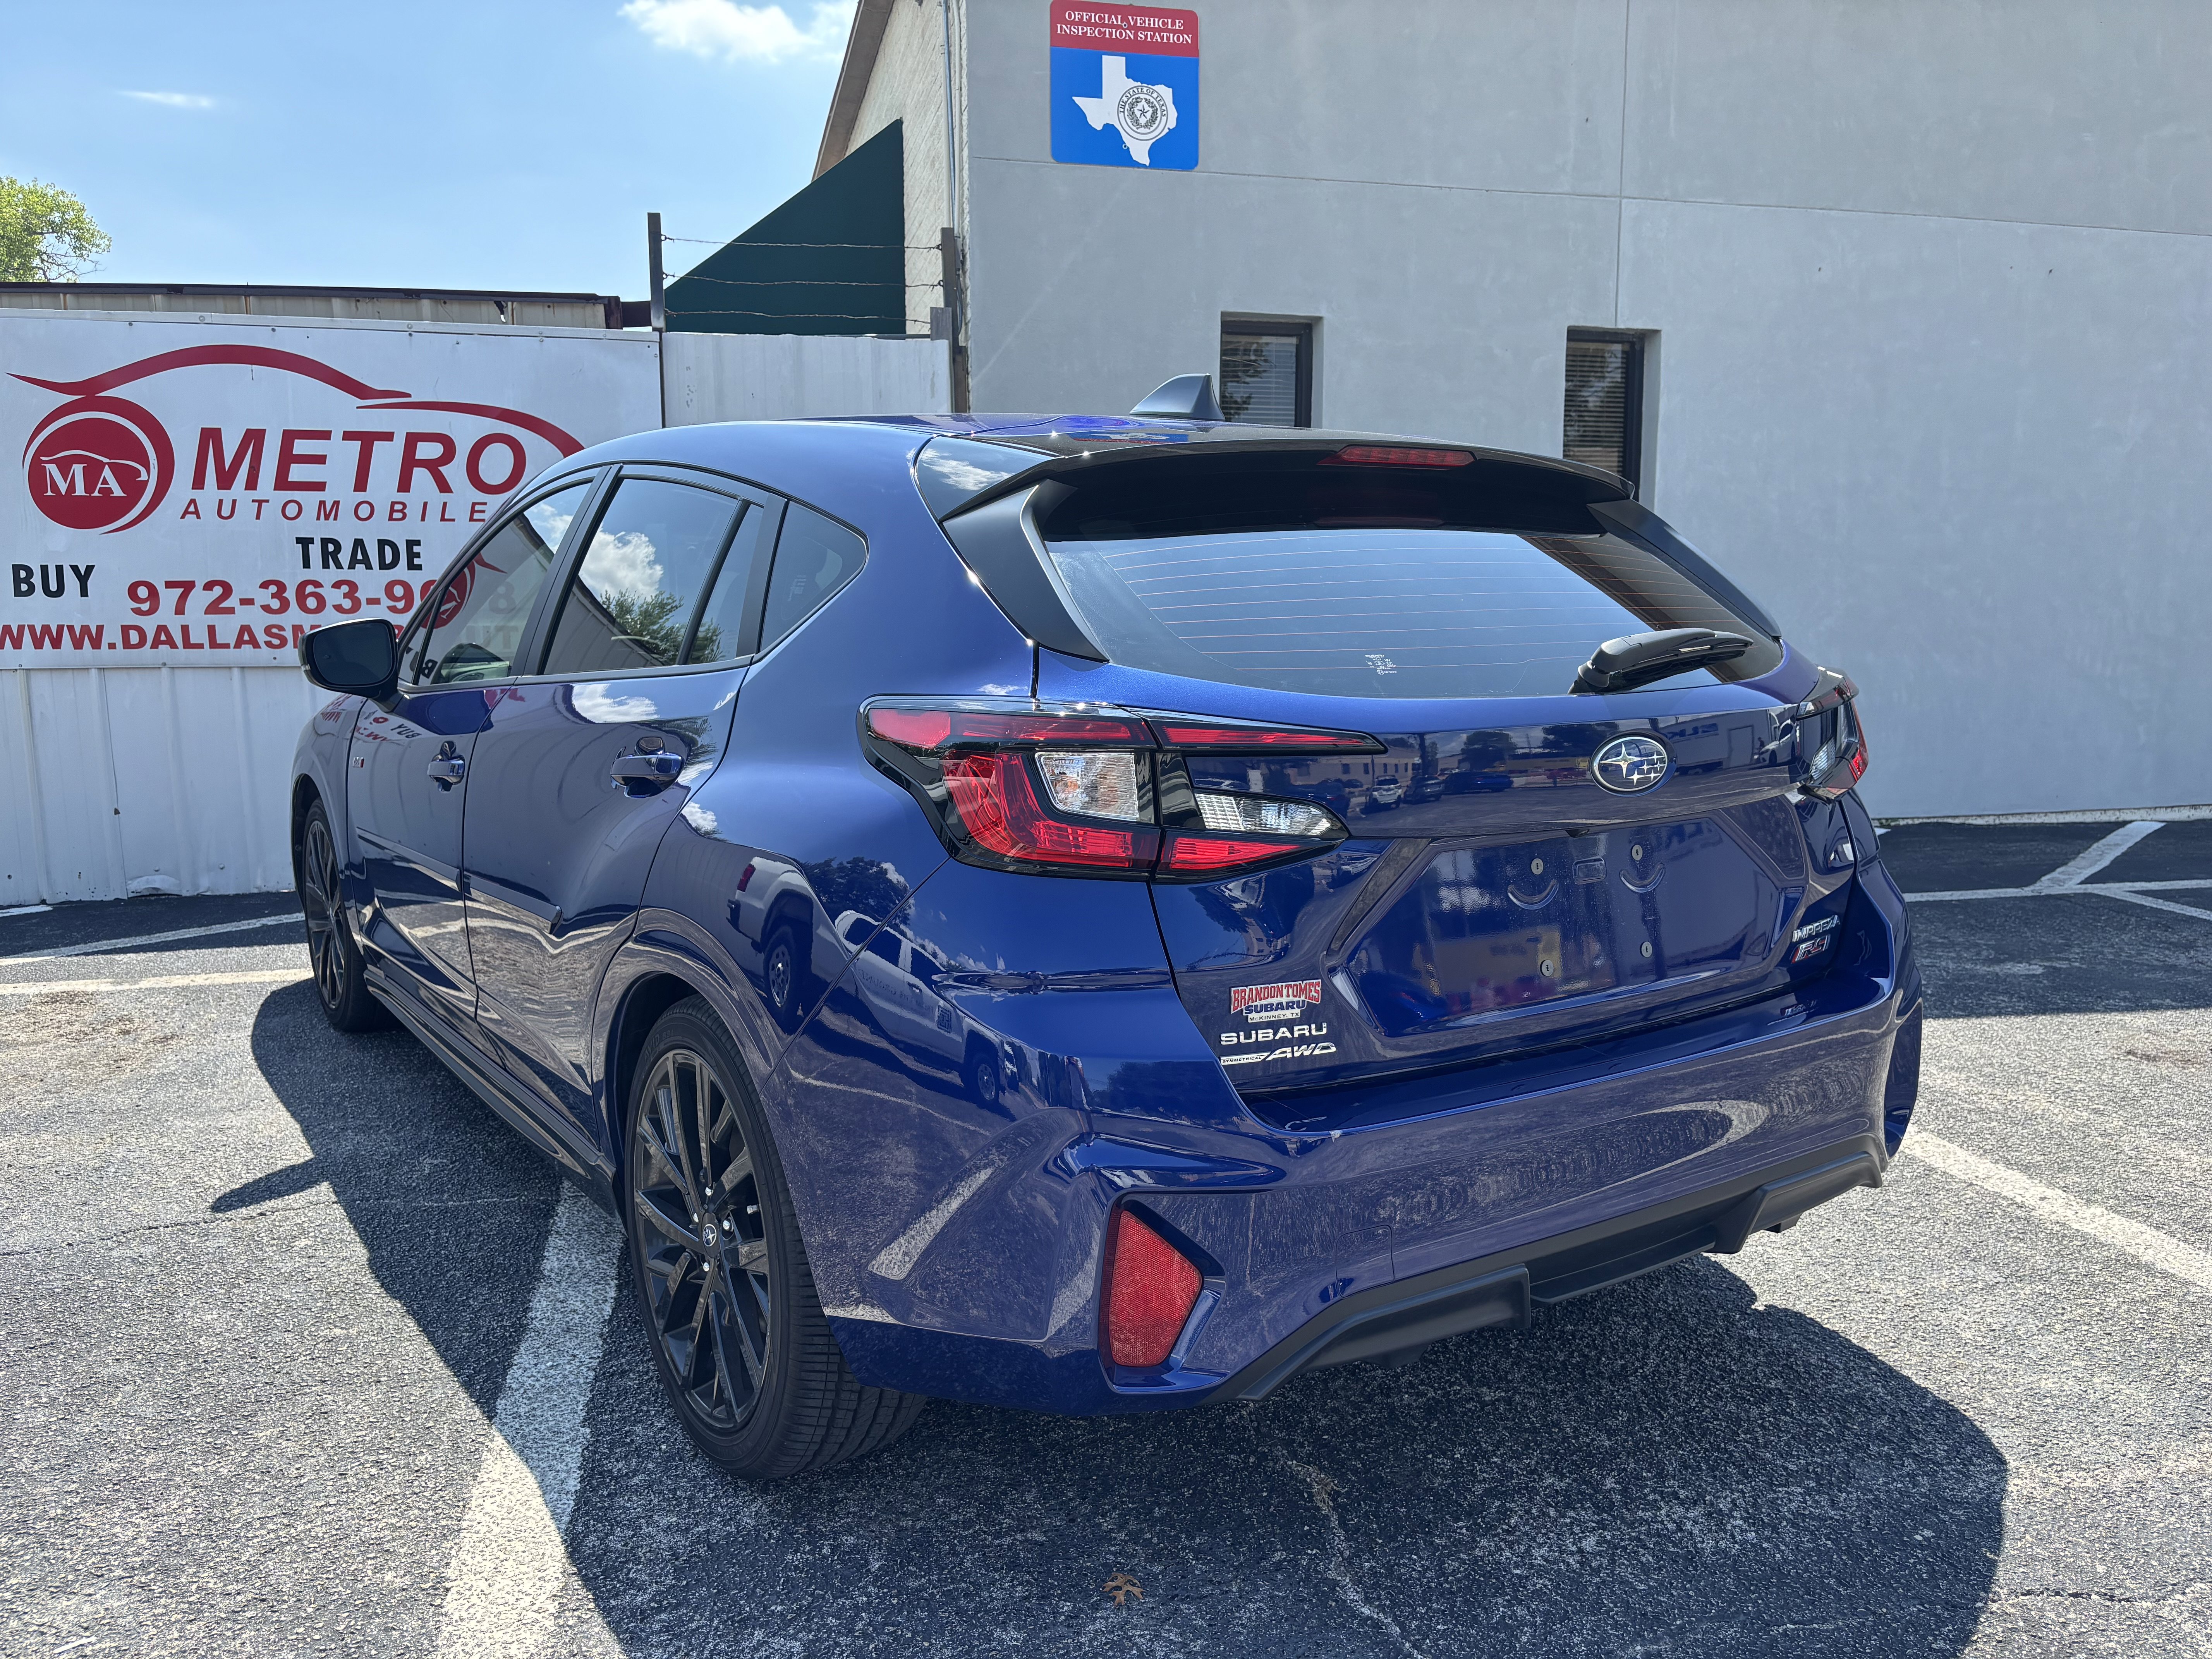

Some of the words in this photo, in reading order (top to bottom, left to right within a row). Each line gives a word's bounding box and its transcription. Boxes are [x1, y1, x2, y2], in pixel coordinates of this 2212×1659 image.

[1065, 10, 1124, 25] OFFICIAL
[1128, 16, 1184, 30] VEHICLE
[1056, 24, 1135, 40] INSPECTION
[1137, 31, 1192, 44] STATION
[1124, 88, 1145, 100] STATE
[1155, 94, 1166, 117] TEXAS
[191, 427, 527, 495] METRO
[41, 464, 127, 496] MA
[295, 536, 423, 571] TRADE
[11, 564, 96, 598] BUY
[1244, 1000, 1306, 1015] SUBARU
[1220, 1022, 1327, 1045] SUBARU
[1222, 1056, 1262, 1064] SYMMETRICAL
[1265, 1042, 1336, 1061] AWD
